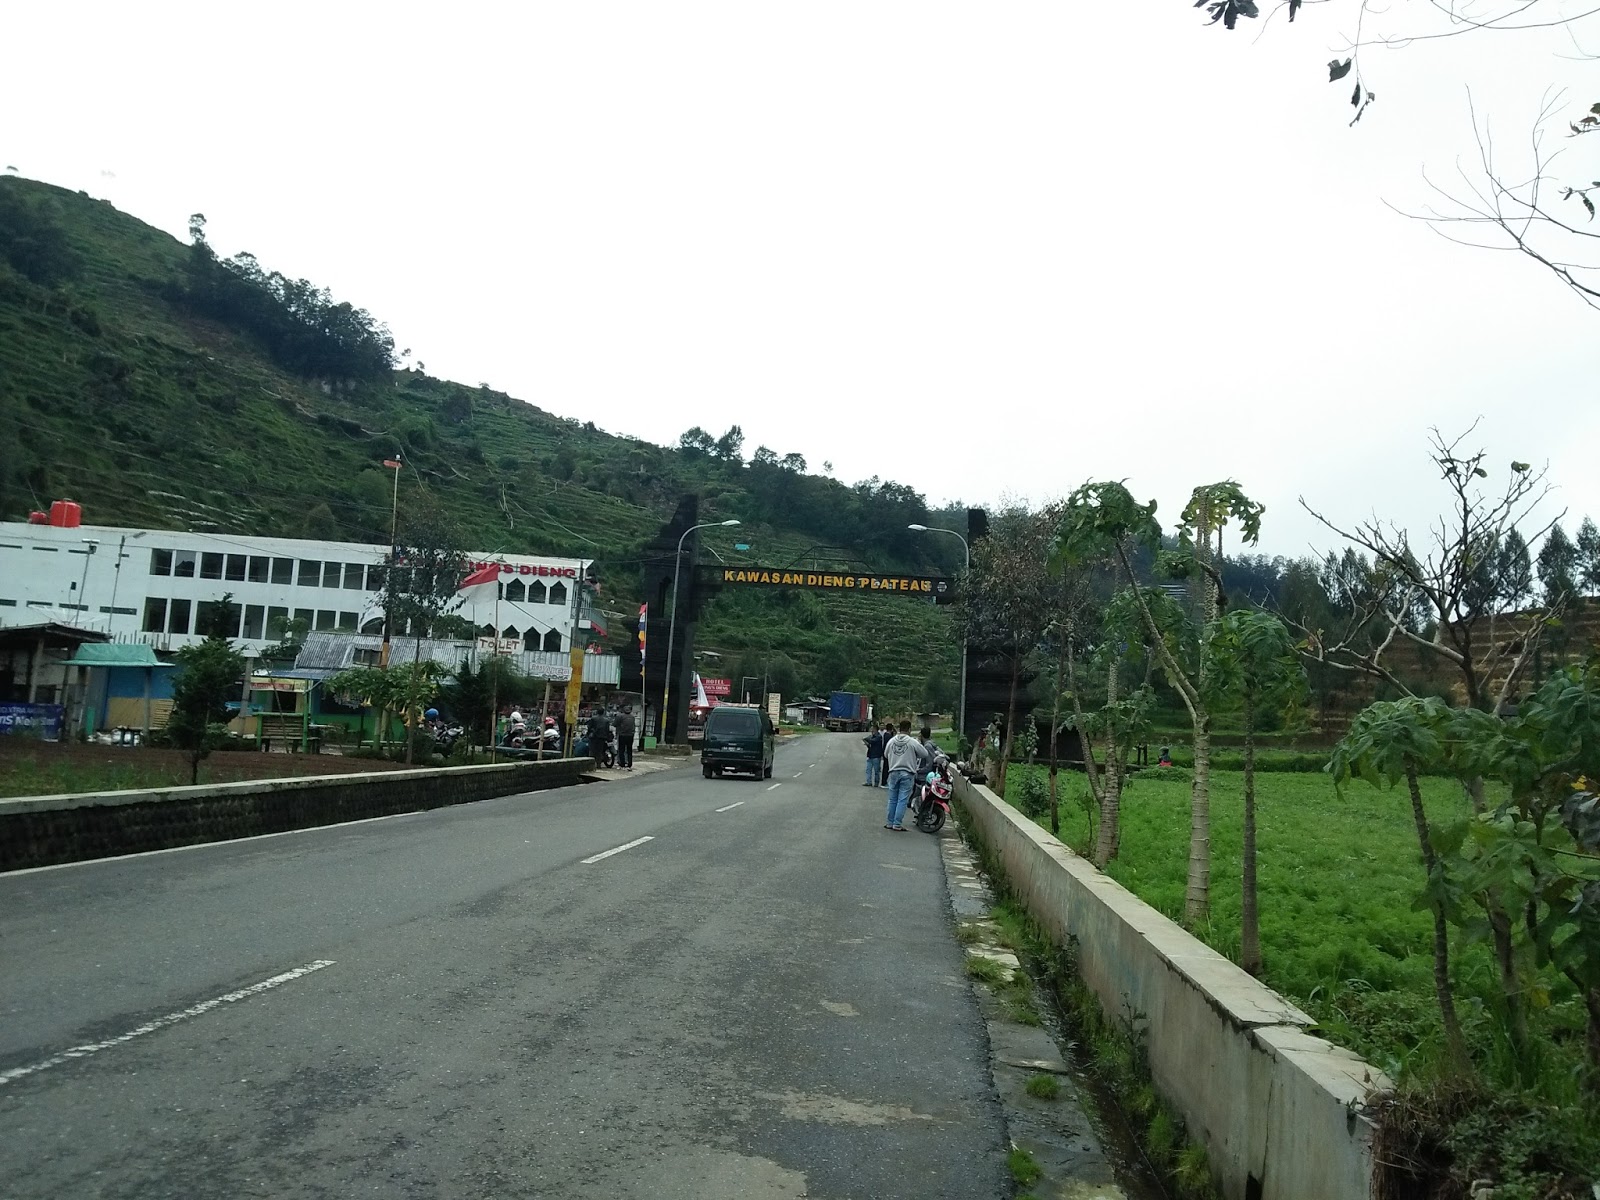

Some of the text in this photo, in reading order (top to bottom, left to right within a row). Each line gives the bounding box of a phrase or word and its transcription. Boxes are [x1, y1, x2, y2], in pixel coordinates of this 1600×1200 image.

[725, 570, 930, 592] KAWASAN DIENG PLATEAU
